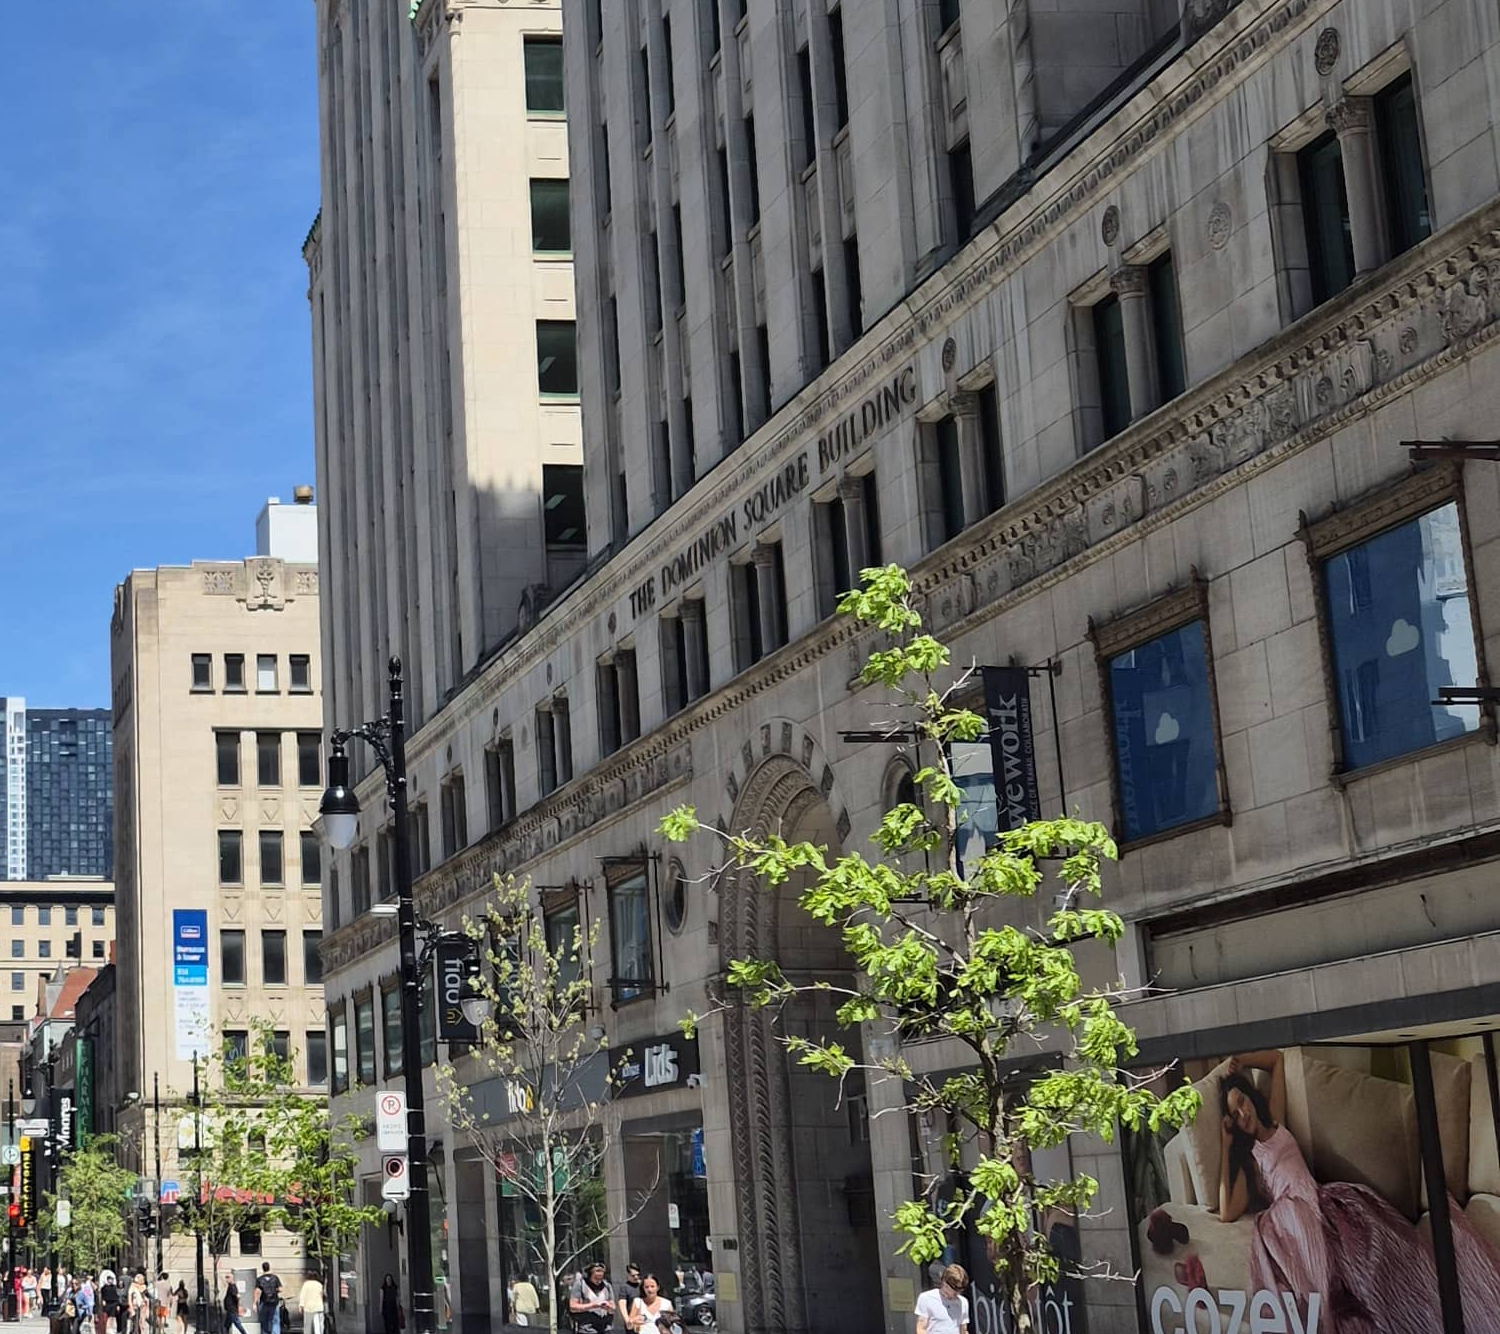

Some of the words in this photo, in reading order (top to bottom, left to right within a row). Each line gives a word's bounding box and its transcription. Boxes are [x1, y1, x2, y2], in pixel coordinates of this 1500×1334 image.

[628, 576, 656, 620] THE
[661, 511, 738, 597] DOMINION
[743, 451, 810, 532] SQUARE
[817, 366, 917, 473] BUILDING
[644, 1043, 679, 1087] Lids
